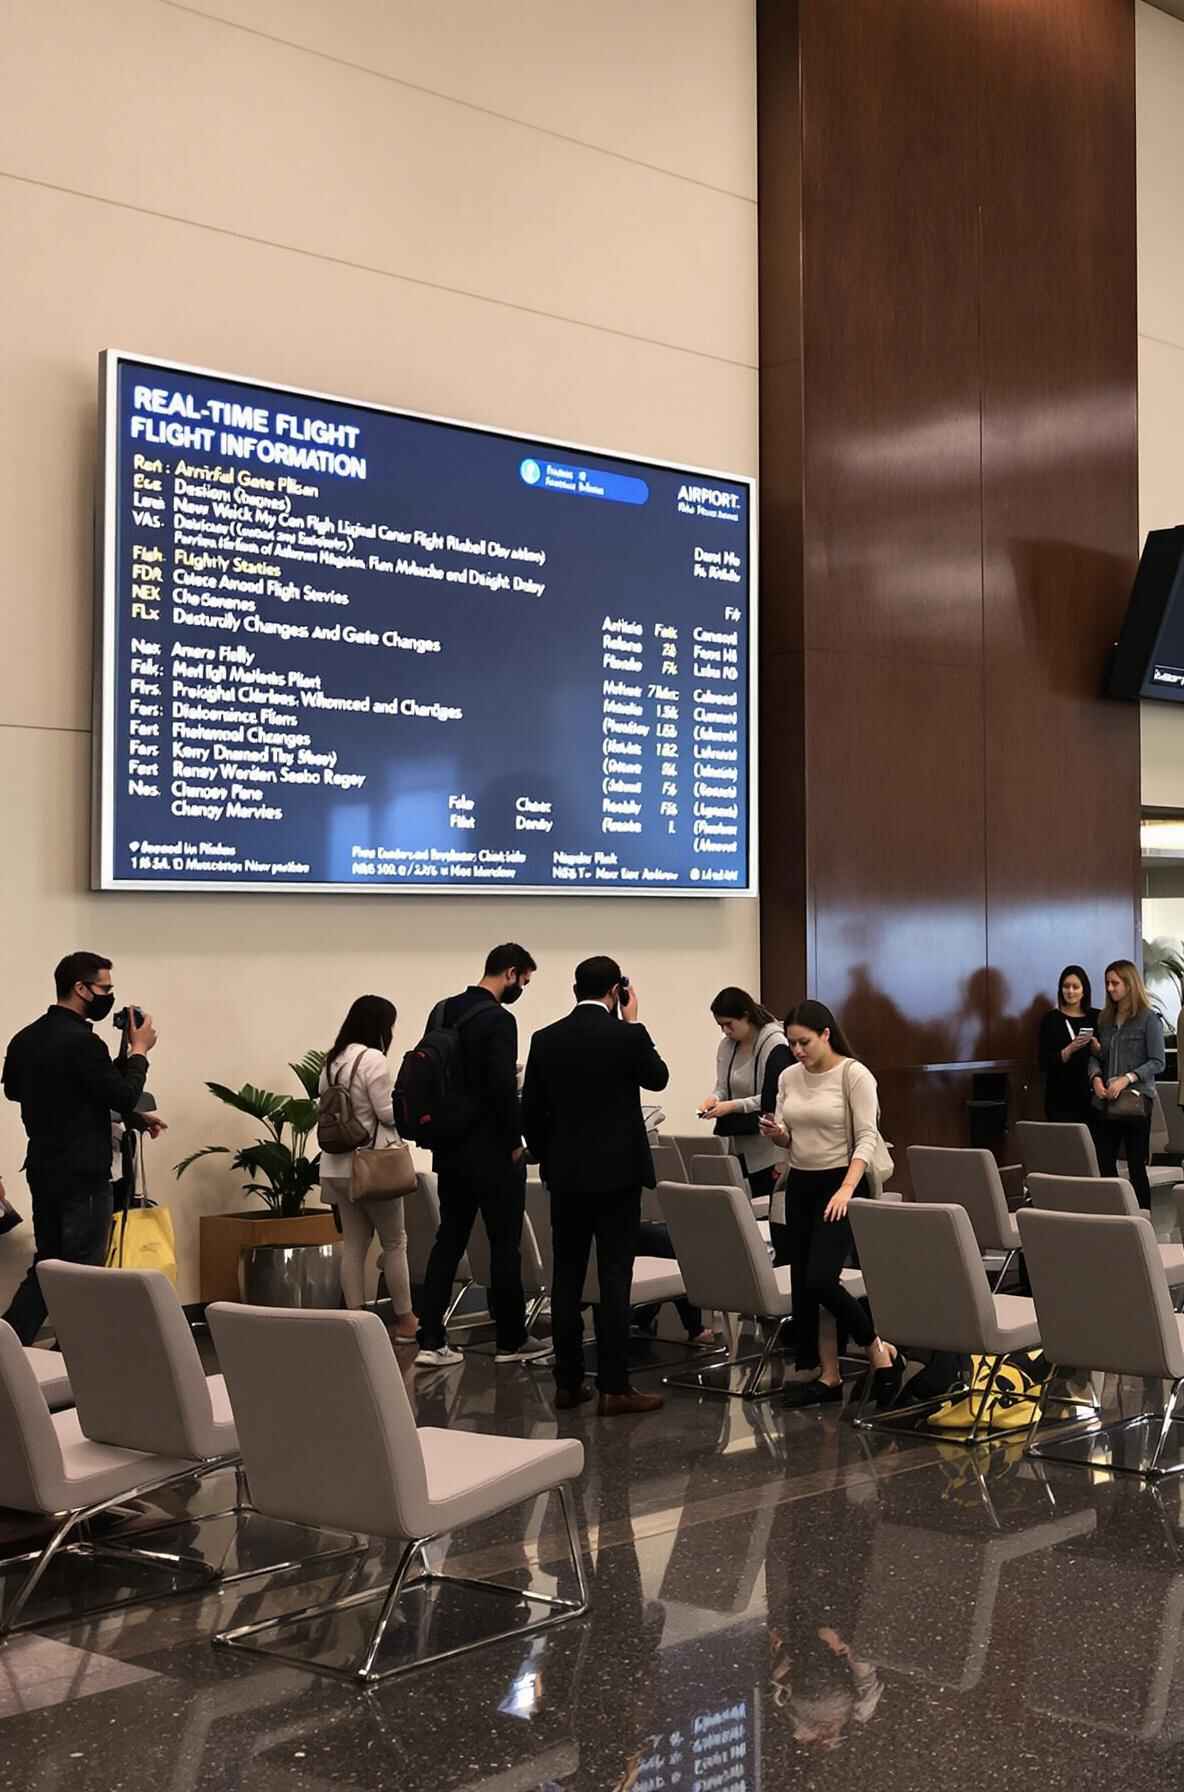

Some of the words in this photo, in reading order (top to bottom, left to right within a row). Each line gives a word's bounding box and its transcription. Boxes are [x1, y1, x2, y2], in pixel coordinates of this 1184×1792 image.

[131, 416, 215, 451] FLIGHT
[221, 432, 366, 479] INFORMATION
[134, 385, 270, 433] REAL-TIME
[276, 413, 360, 448] FLIGHT
[382, 631, 442, 654] Changes
